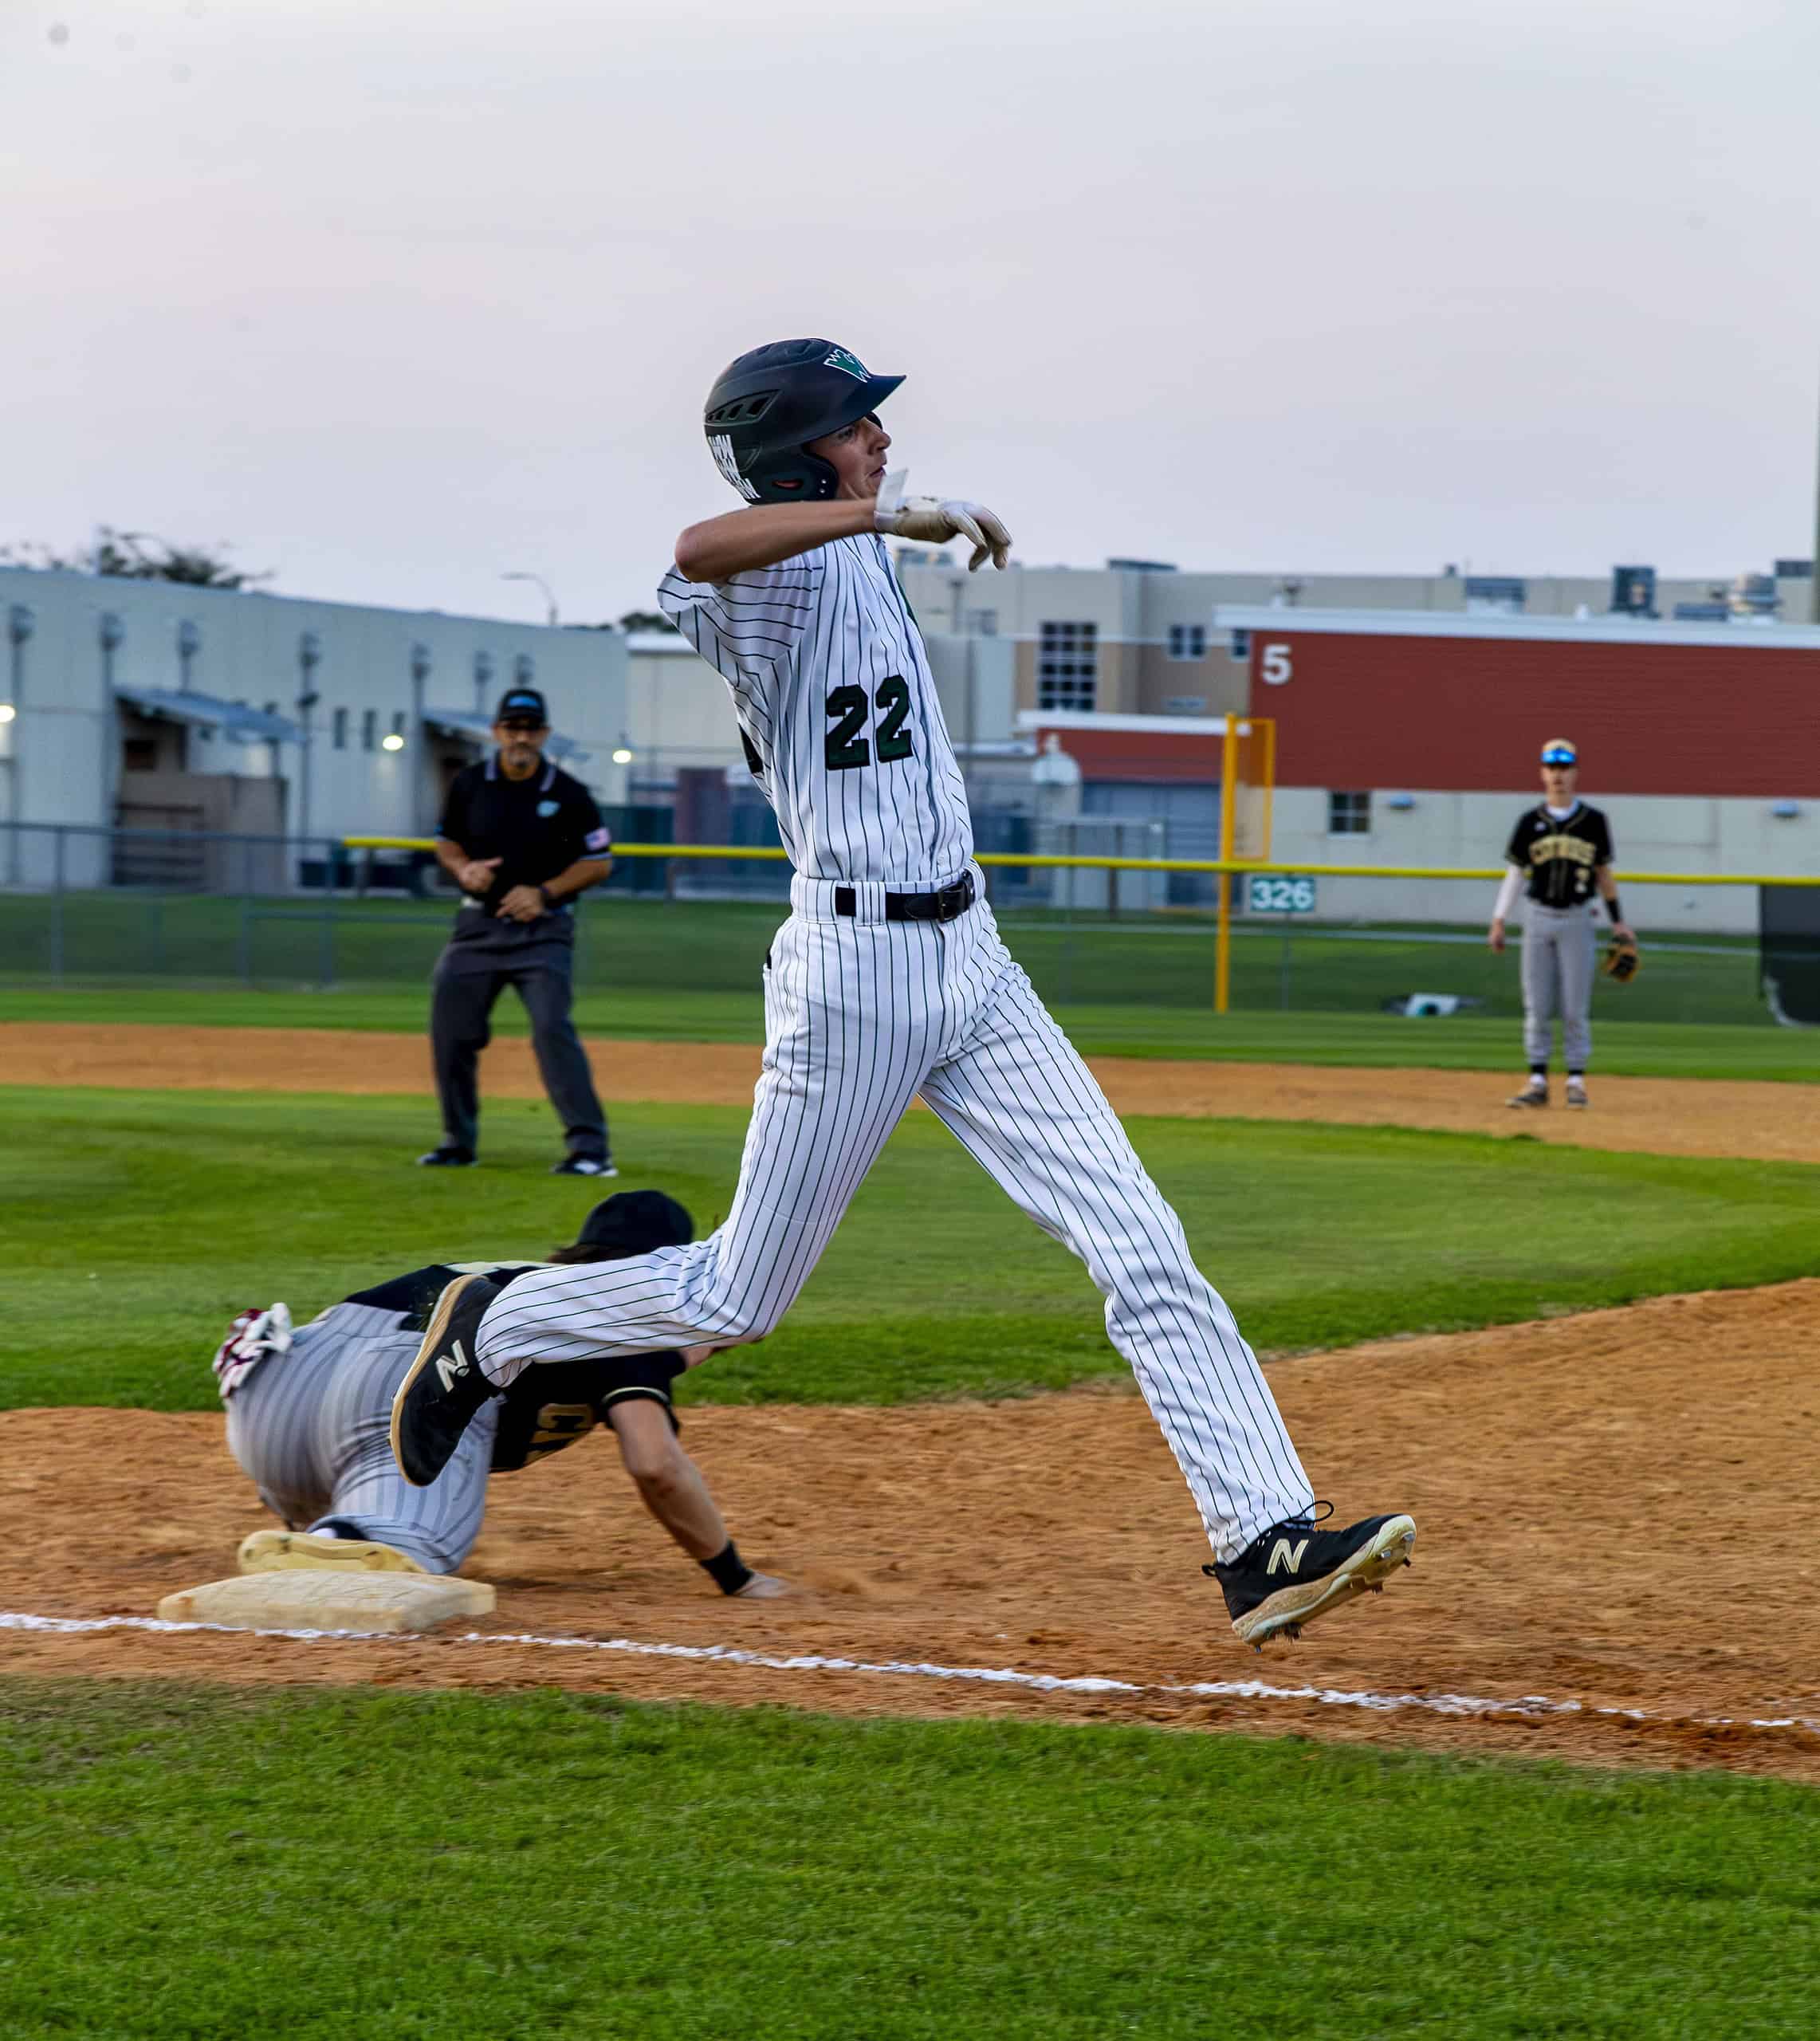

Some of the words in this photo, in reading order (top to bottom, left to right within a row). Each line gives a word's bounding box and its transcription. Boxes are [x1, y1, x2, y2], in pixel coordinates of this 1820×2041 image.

[1262, 643, 1292, 686] 5
[825, 674, 913, 770] 22
[1252, 879, 1314, 909] 326
[435, 1339, 471, 1393] N
[1266, 1538, 1309, 1575] N
